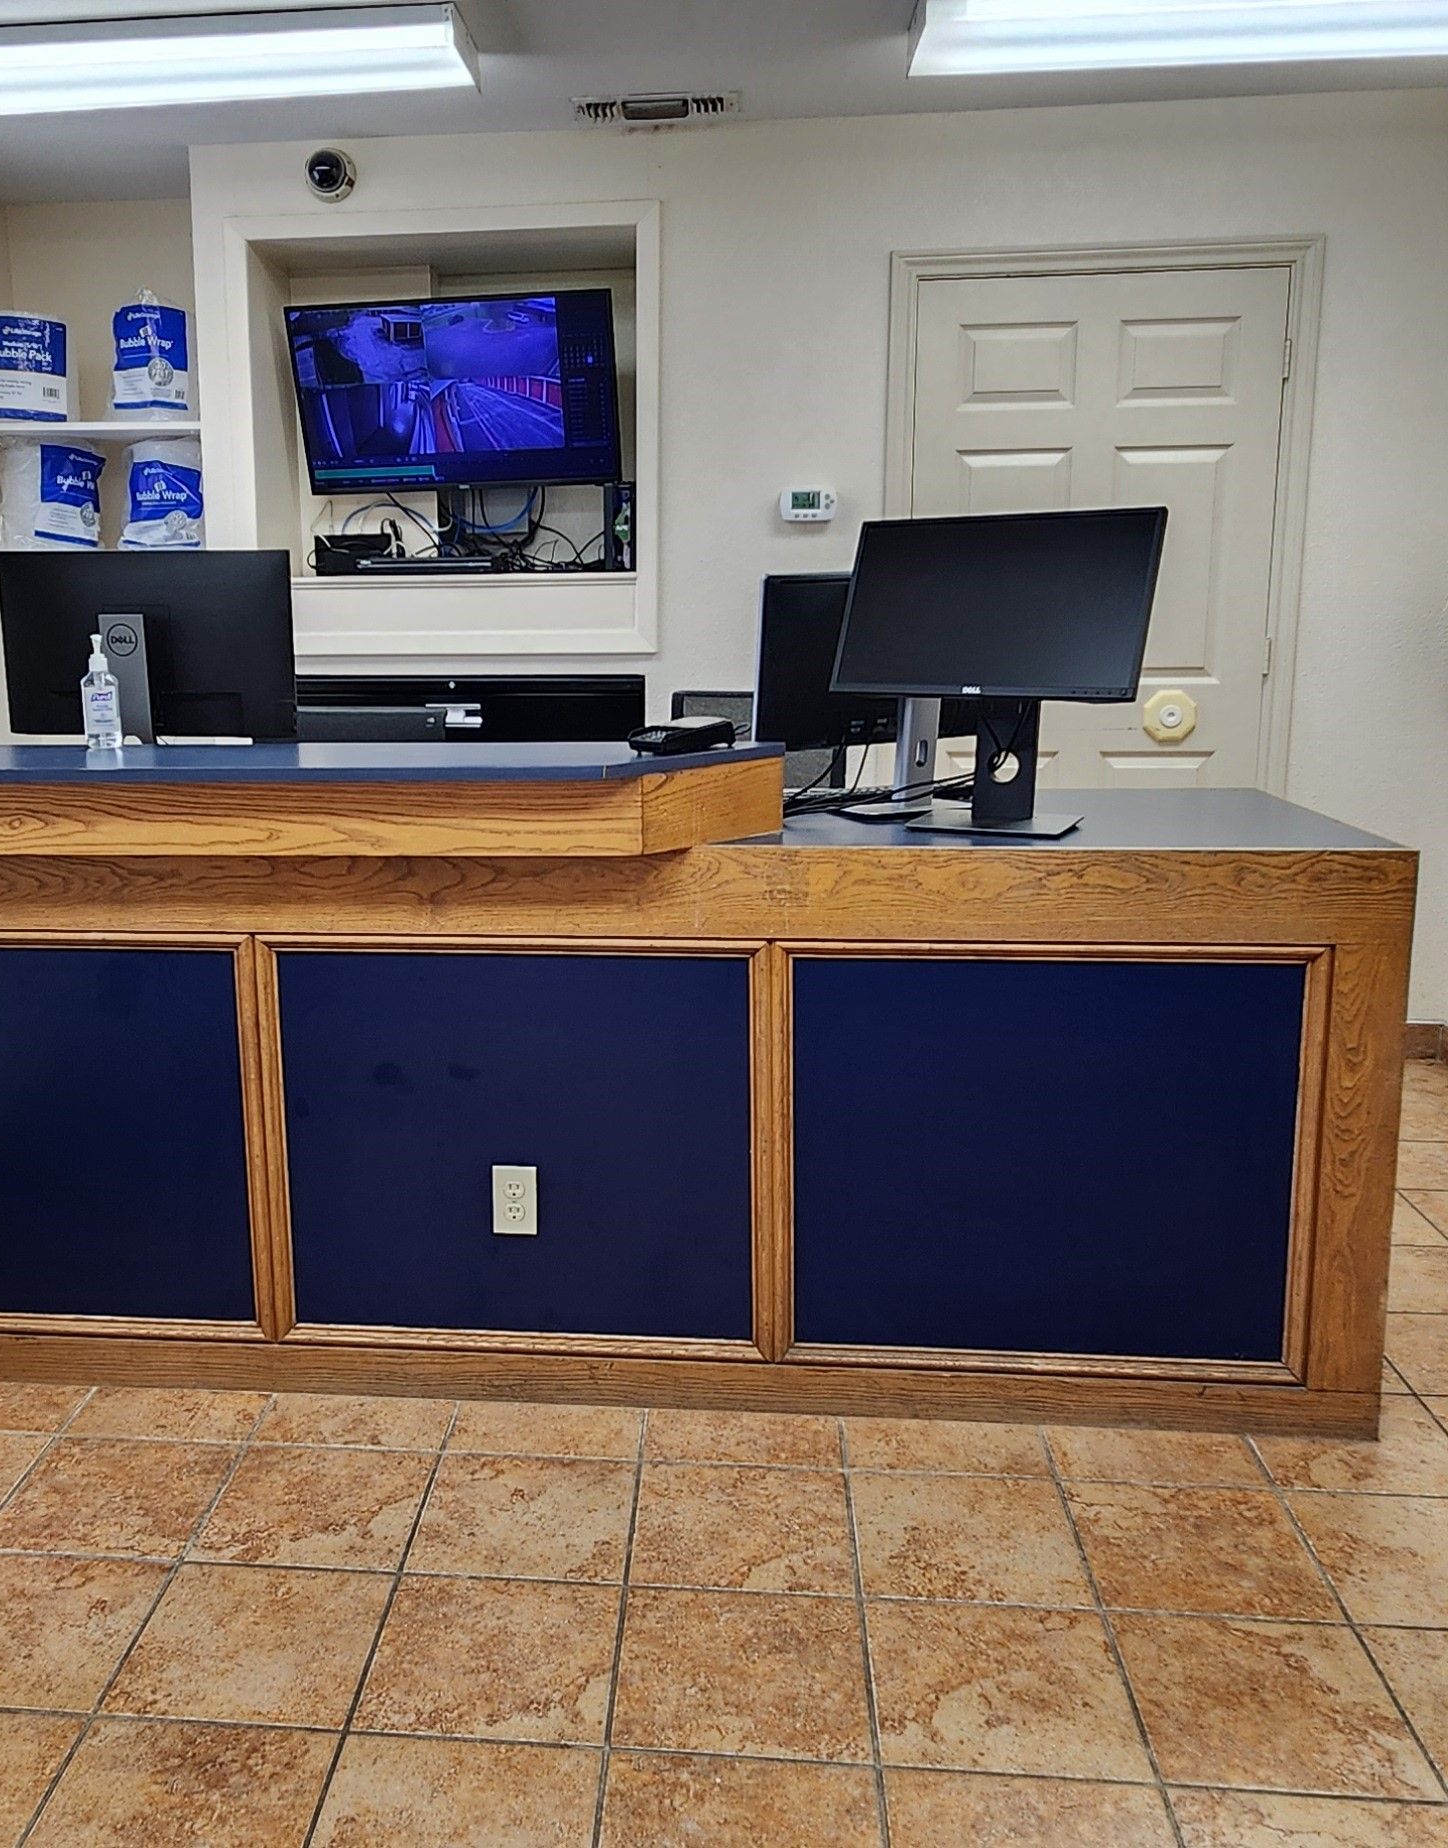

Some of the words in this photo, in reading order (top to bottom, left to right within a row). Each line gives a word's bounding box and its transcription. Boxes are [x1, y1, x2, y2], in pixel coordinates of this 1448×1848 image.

[120, 336, 146, 348] Bubble
[29, 349, 52, 362] Pack
[162, 490, 187, 502] Wrap
[111, 635, 135, 645] DELL
[962, 686, 981, 694] DELL
